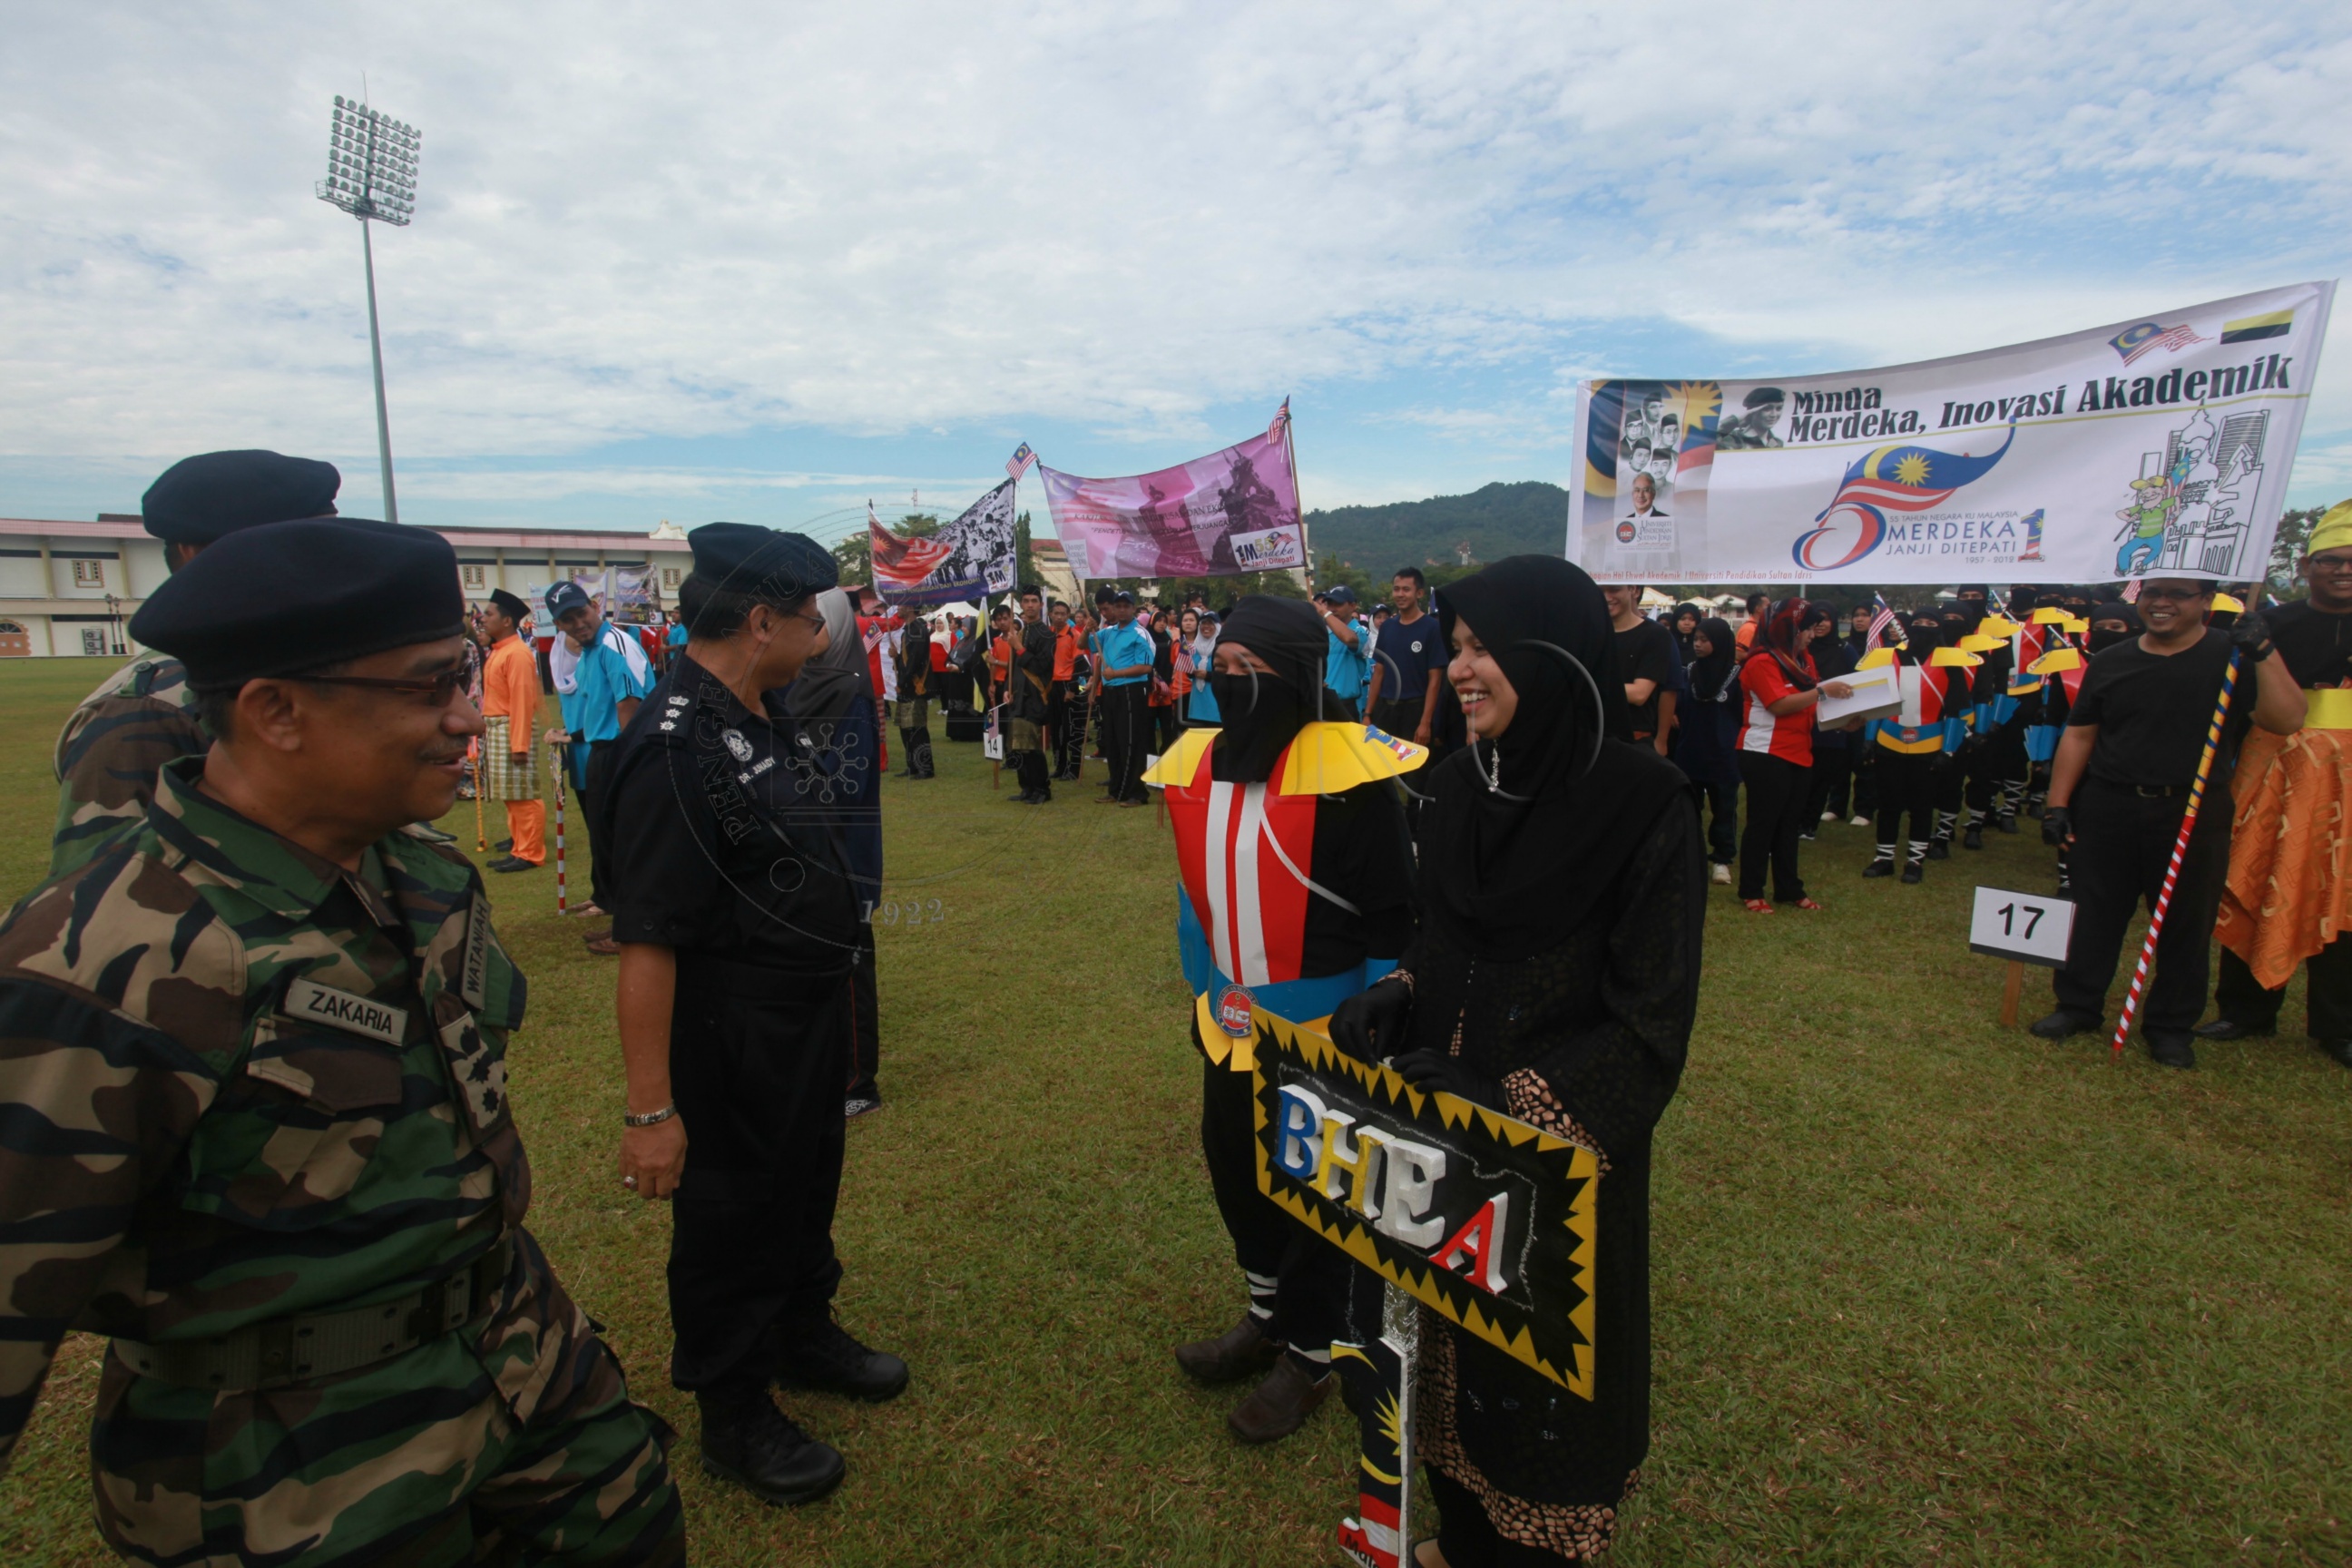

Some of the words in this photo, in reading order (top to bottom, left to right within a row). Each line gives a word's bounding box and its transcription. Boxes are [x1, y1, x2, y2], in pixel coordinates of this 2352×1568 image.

[1788, 408, 1926, 442] Merdeka,
[1938, 385, 2067, 428] Inovasi
[2076, 353, 2293, 413] Akademik
[1792, 387, 1882, 415] Minda
[1901, 514, 1928, 522] TAHUN
[1930, 513, 1963, 521] NEGARA
[1976, 511, 2018, 519] MALAYSIA
[1887, 521, 2016, 542] MERDEKA
[1886, 543, 1931, 555] JANJI
[1941, 541, 2016, 554] DITEPATI
[1994, 555, 2014, 564] 2012
[1612, 571, 1623, 580] Hal
[1626, 571, 1645, 580] Ehwal
[1647, 571, 1681, 580] Akademik
[1689, 571, 1724, 580] Universiti
[1726, 571, 1767, 580] Pendidikan
[1769, 571, 1793, 580] Sultan
[1795, 570, 1812, 580] Idris
[988, 738, 998, 754] 14
[739, 772, 754, 784] DR.
[1998, 902, 2044, 940] 17
[466, 903, 488, 994] WATANIAH
[308, 990, 392, 1034] ZAKARIA
[1272, 1083, 1508, 1297] BHEA
[1345, 1534, 1379, 1568] Mal
